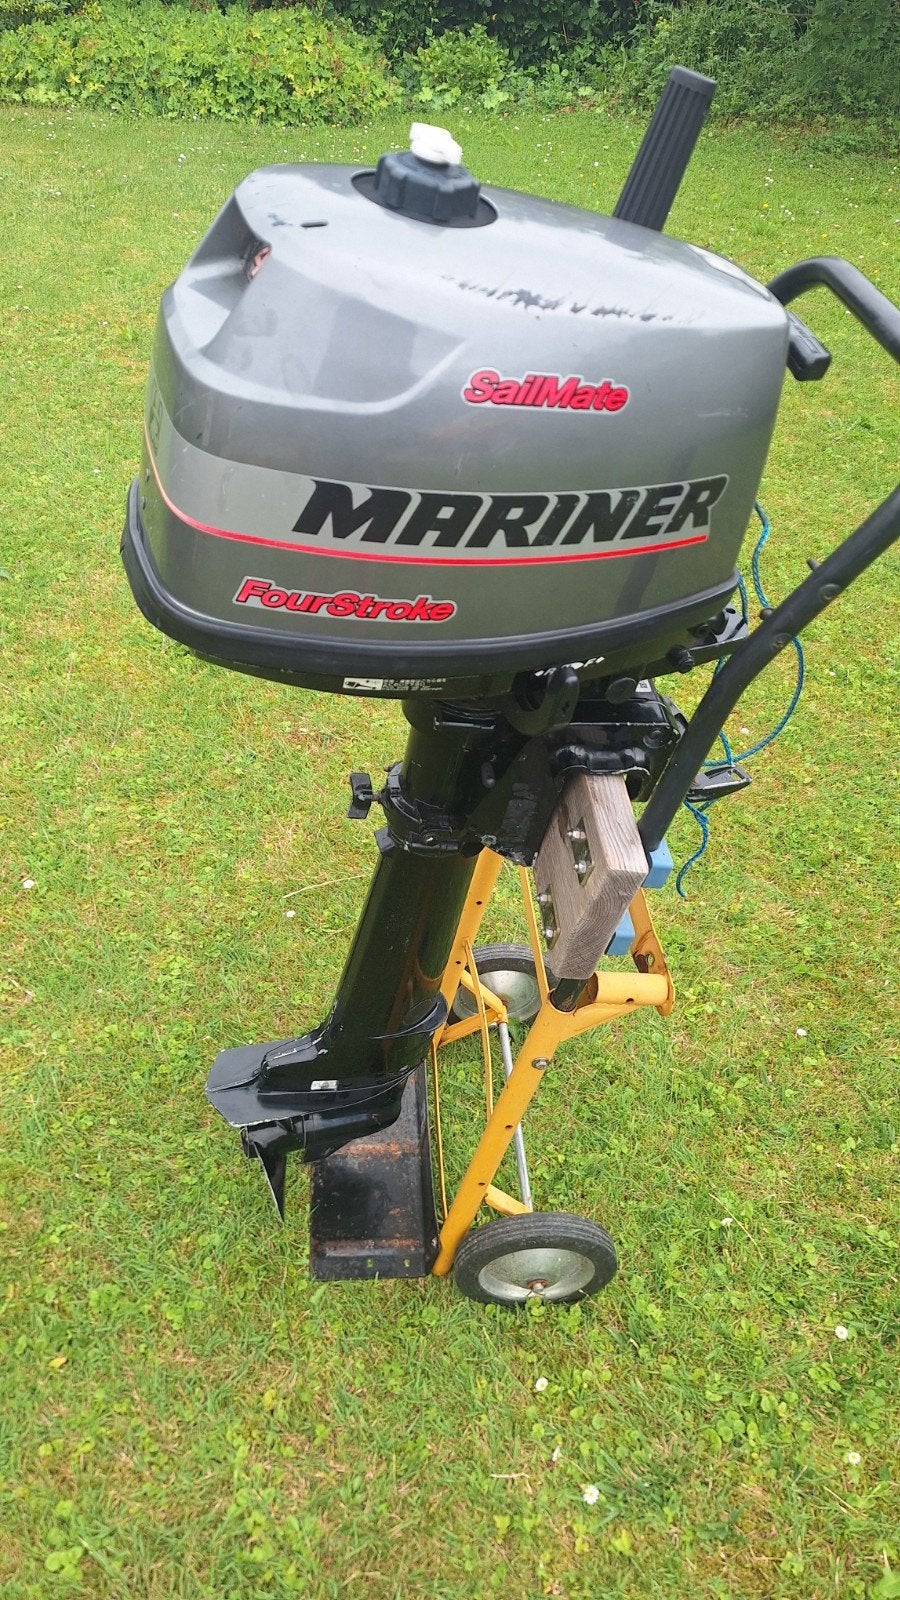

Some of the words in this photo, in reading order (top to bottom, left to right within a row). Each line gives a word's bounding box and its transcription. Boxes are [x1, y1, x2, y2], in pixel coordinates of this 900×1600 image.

[463, 369, 629, 411] SailMate
[292, 475, 728, 548] MARINER
[235, 578, 455, 621] FourStroke
